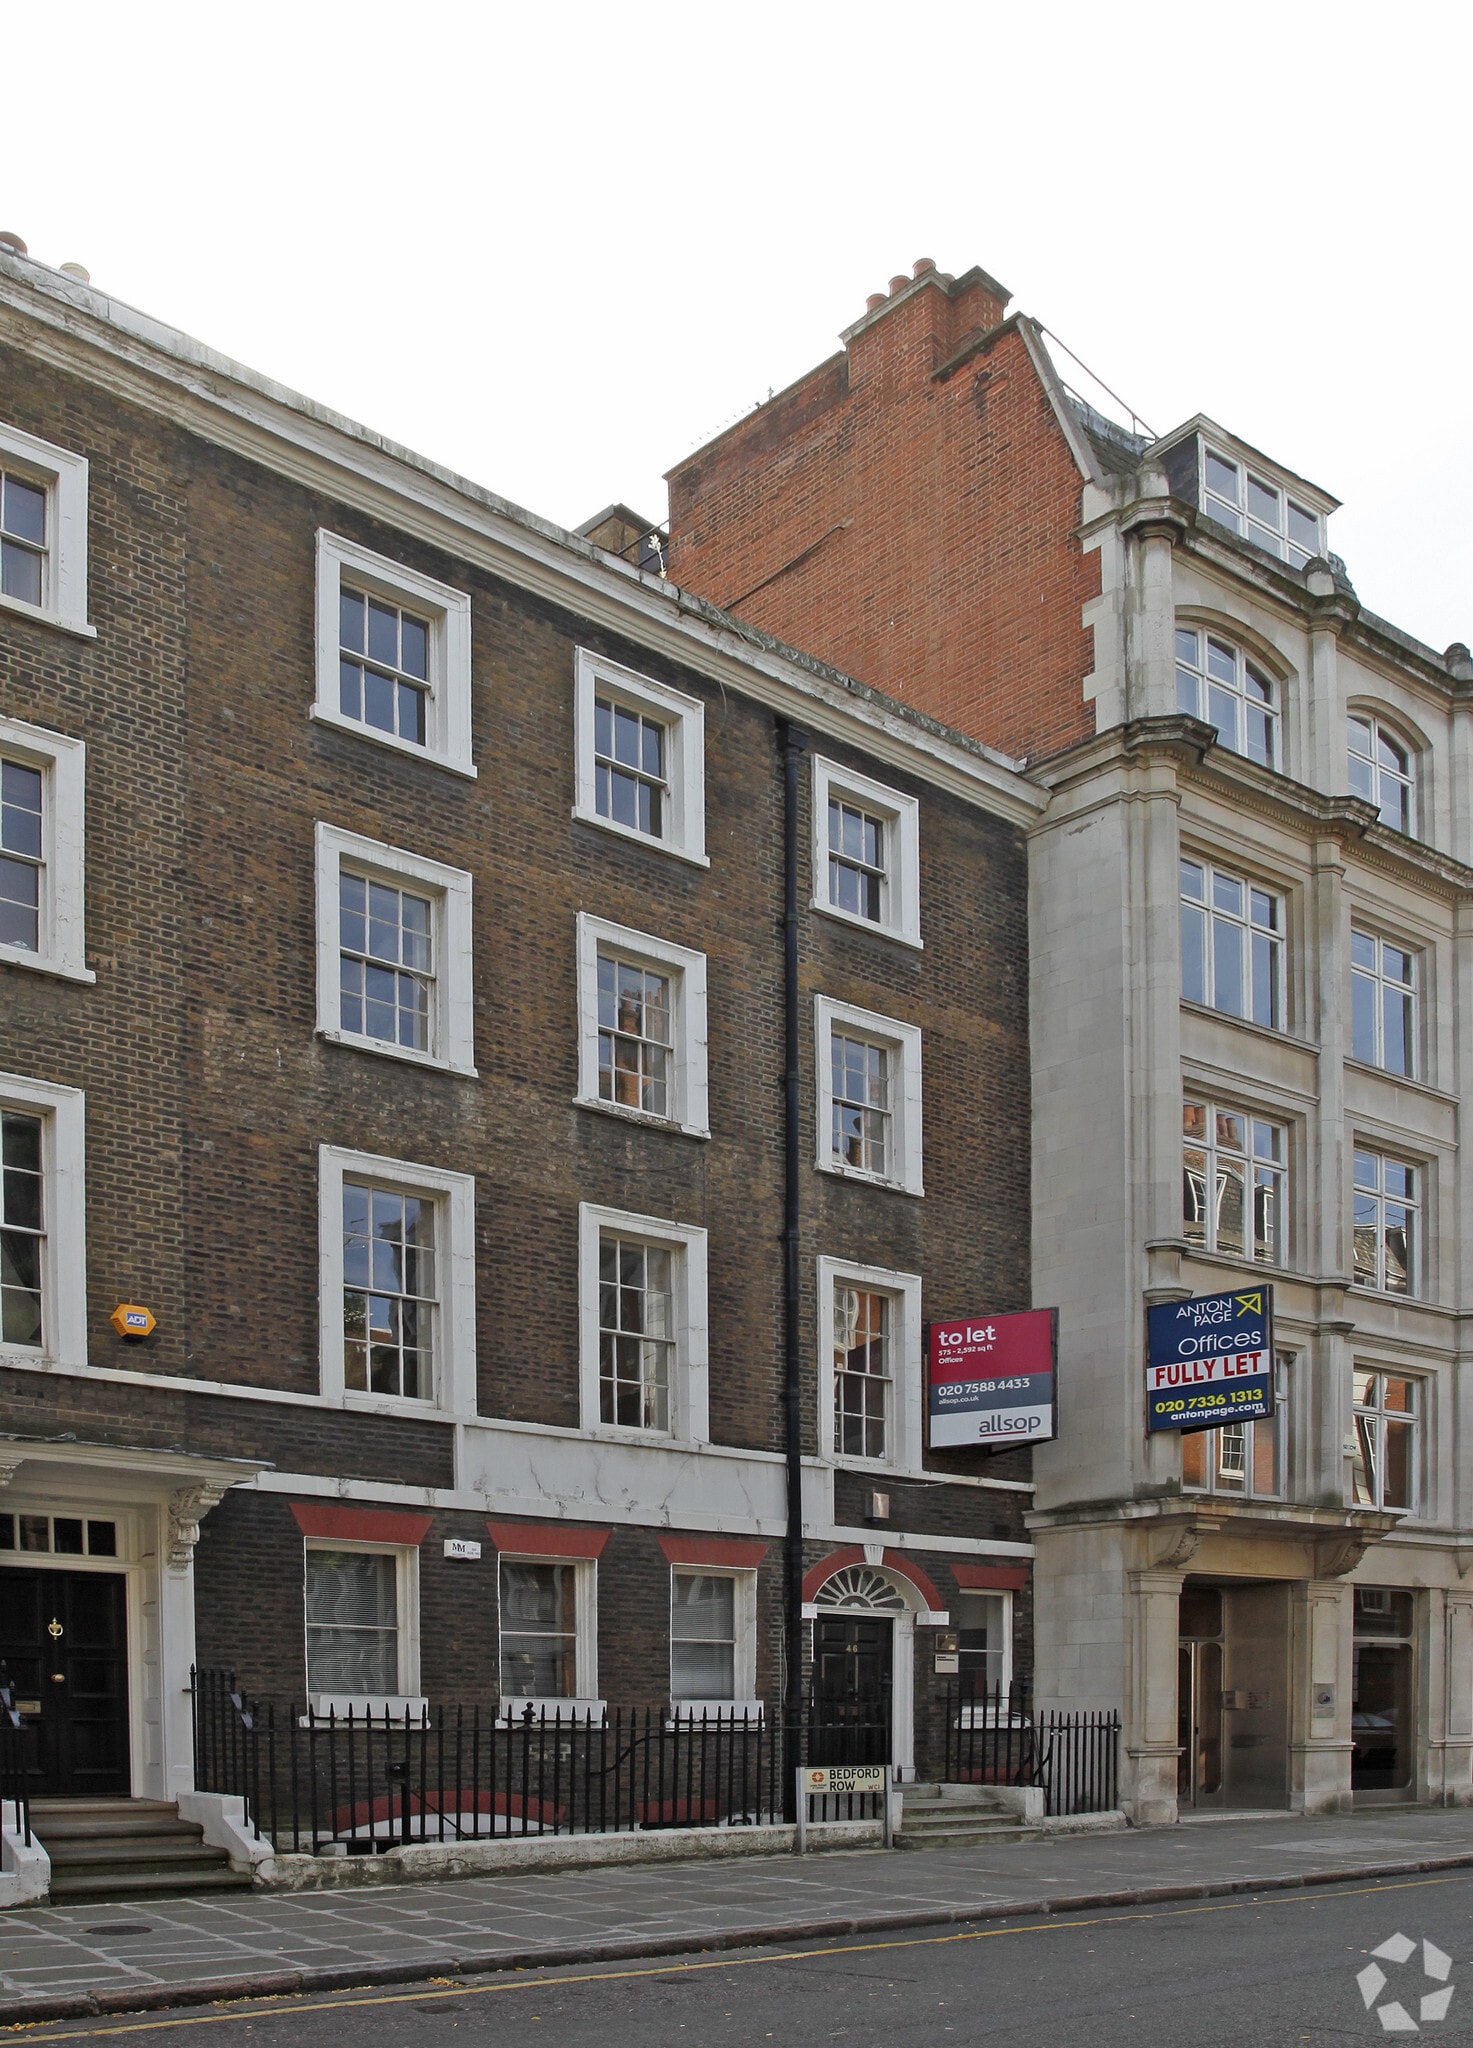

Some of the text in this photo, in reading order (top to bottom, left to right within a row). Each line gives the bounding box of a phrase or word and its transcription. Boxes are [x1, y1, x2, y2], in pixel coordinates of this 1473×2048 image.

[1176, 1298, 1232, 1319] ANTON
[127, 1315, 146, 1325] ADT
[1194, 1310, 1232, 1327] PAGE
[938, 1325, 997, 1346] to let
[1178, 1330, 1262, 1355] Offices
[977, 1345, 986, 1353] sq
[1155, 1351, 1262, 1387] FULLY LET
[938, 1377, 1031, 1396] 020 7588 4433
[938, 1395, 979, 1405] allsop.co.uk
[1155, 1388, 1263, 1413] 020 7336 1313
[1170, 1402, 1263, 1420] antonpage.com
[979, 1414, 1042, 1433] allsop
[845, 1644, 858, 1653] 46
[829, 1768, 880, 1780] BEDFORD
[829, 1780, 855, 1791] ROW
